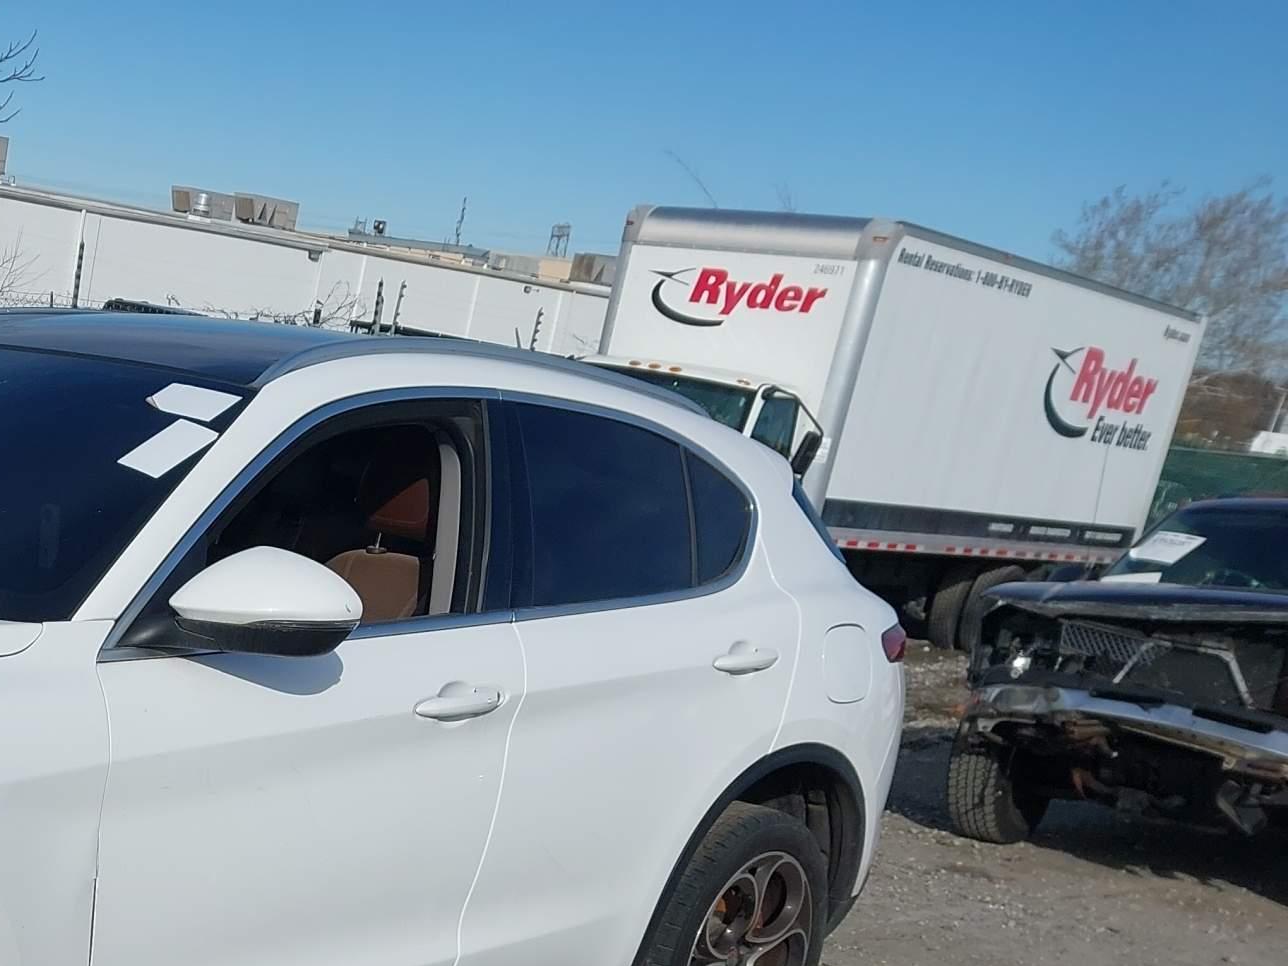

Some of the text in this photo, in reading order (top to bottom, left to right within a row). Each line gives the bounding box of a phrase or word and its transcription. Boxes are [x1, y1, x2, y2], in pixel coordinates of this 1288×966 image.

[688, 267, 829, 316] Ryder
[1069, 346, 1159, 420] Ryder
[1090, 415, 1119, 445] Ever
